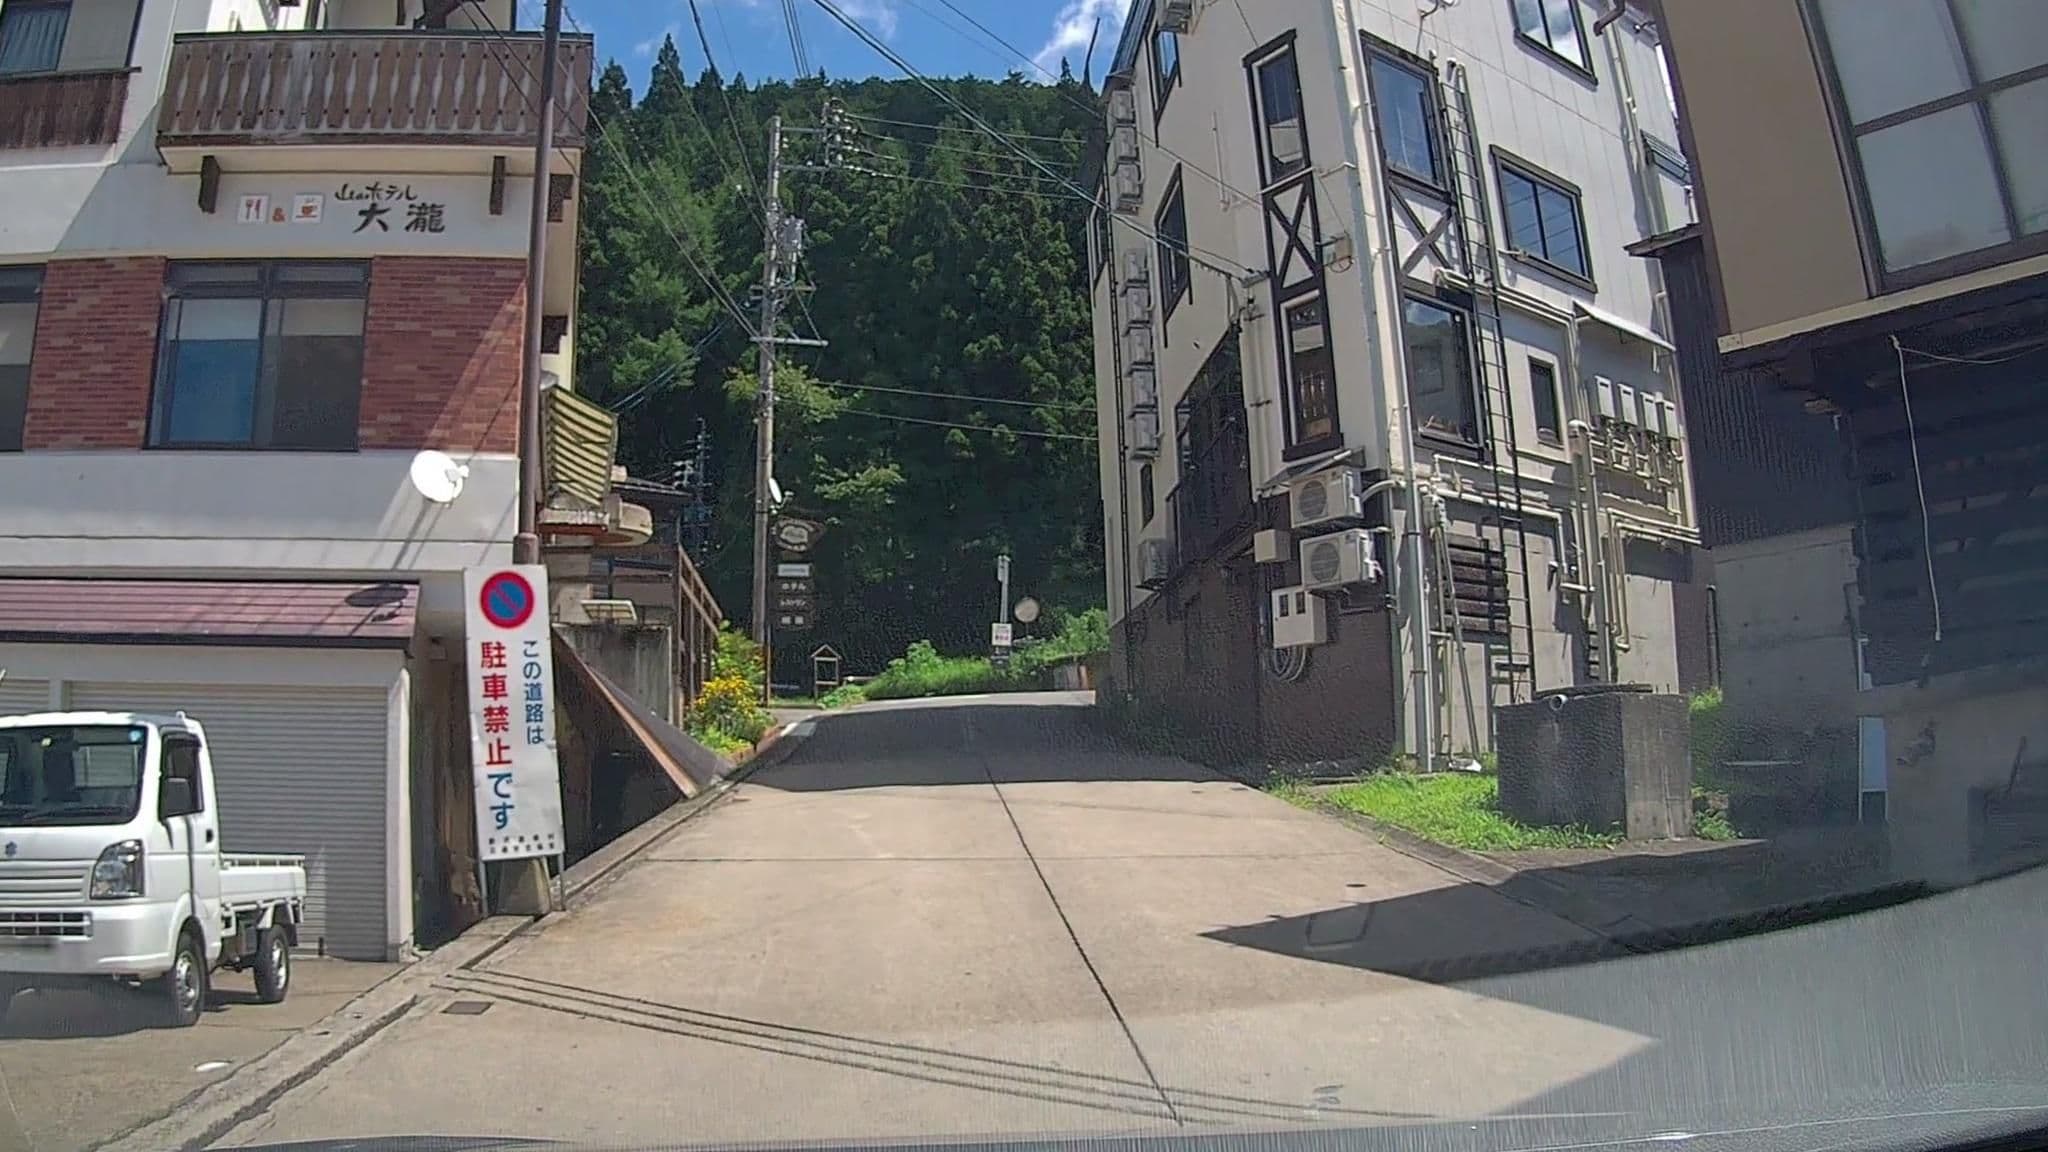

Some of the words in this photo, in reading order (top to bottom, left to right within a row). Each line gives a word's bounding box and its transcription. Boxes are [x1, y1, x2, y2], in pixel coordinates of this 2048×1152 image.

[272, 208, 286, 222] &
[480, 641, 515, 830] 駐車禁止です
[523, 640, 545, 745] この道路は
